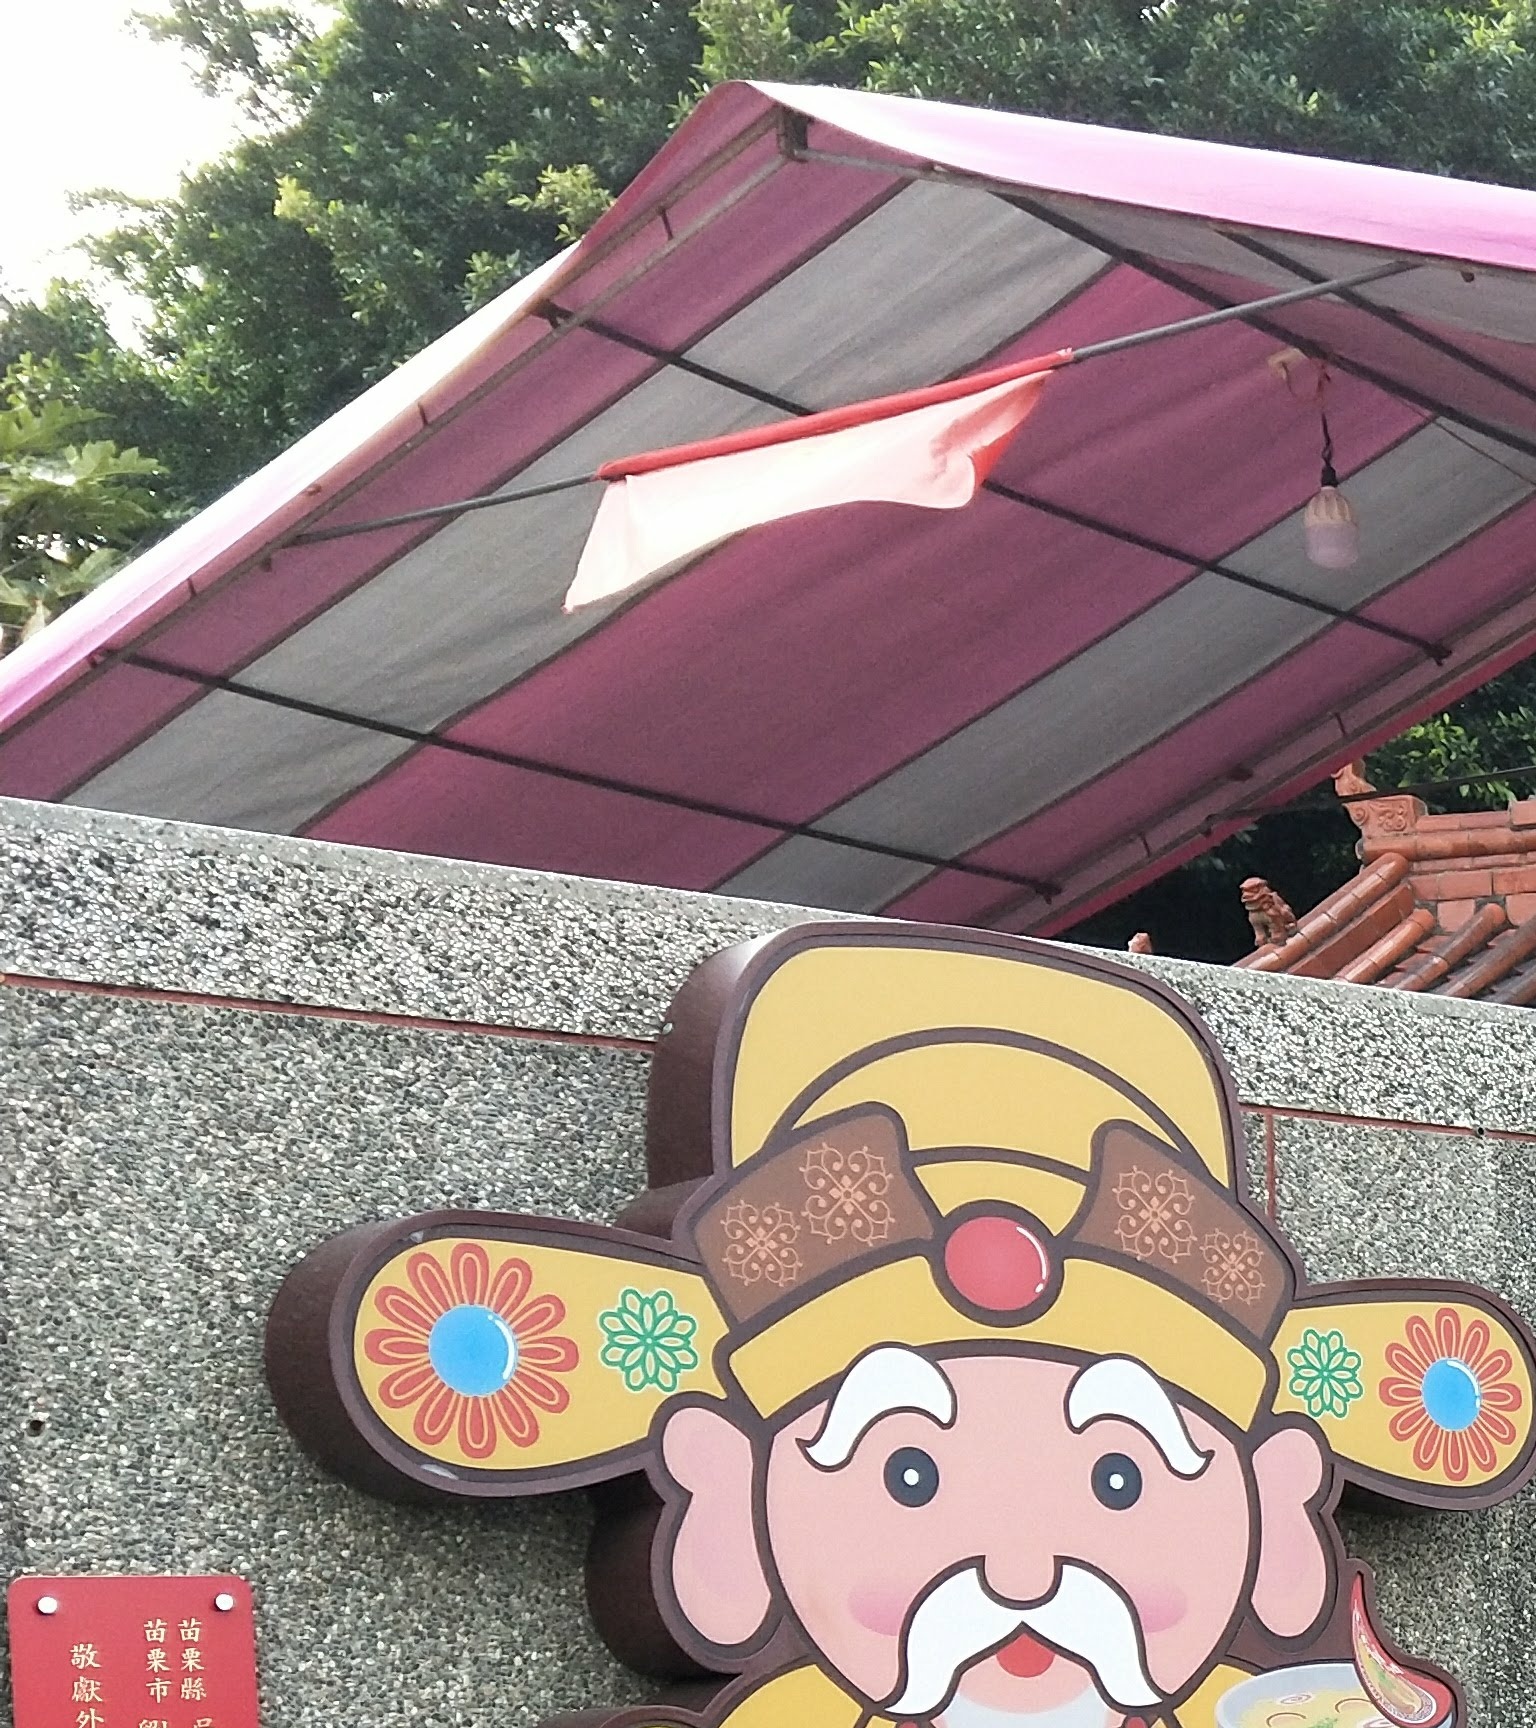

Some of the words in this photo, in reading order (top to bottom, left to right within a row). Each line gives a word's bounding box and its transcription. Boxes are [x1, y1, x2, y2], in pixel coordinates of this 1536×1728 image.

[143, 1618, 172, 1704] 苗栗市
[177, 1617, 207, 1701] 苗栗縣
